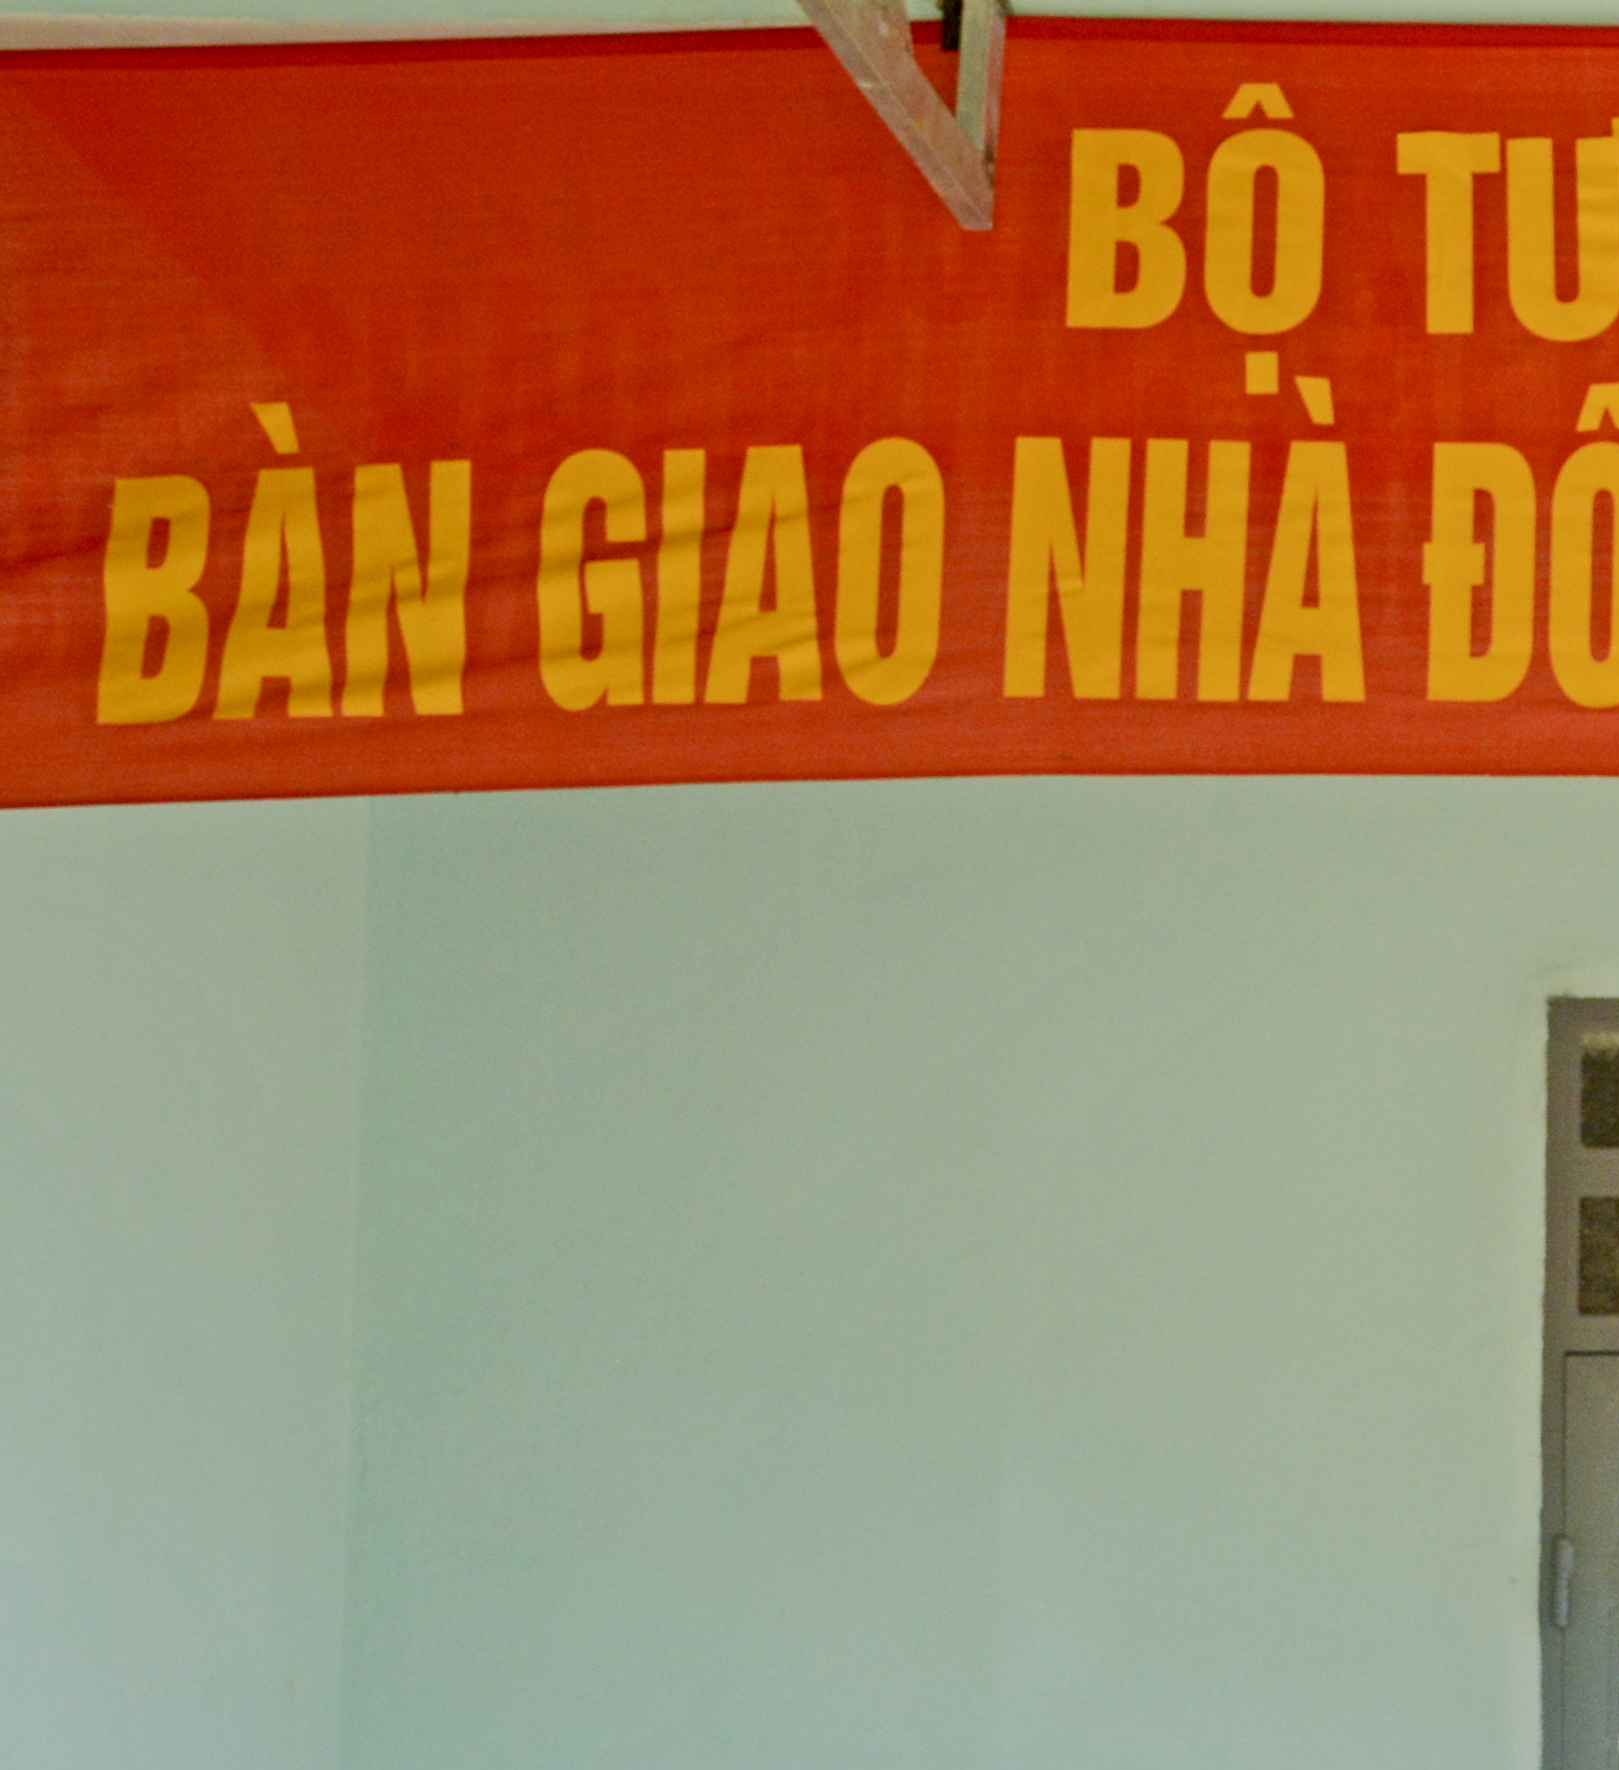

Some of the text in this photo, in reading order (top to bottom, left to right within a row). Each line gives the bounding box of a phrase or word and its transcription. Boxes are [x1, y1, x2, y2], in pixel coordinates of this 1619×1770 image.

[1066, 82, 1325, 396] BỘ
[98, 403, 470, 725] BÀN
[538, 437, 944, 705] GIAO
[1004, 377, 1365, 702] NHÀ
